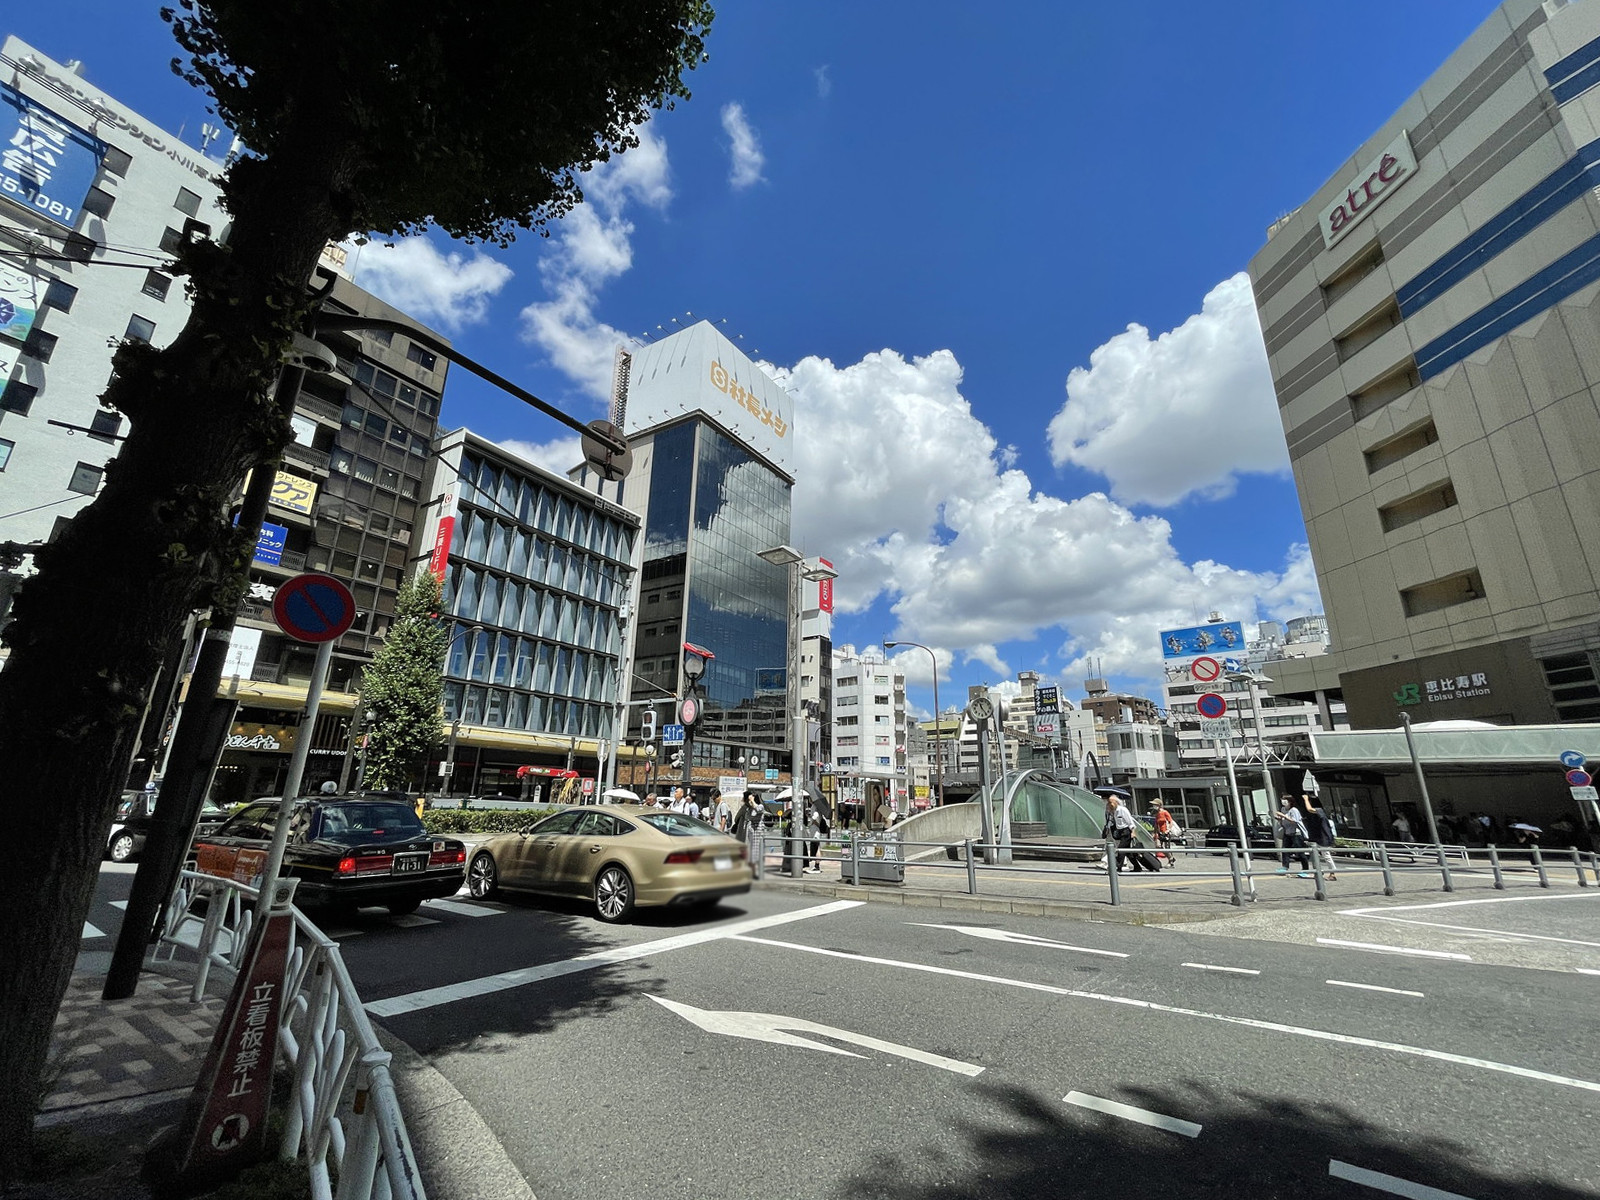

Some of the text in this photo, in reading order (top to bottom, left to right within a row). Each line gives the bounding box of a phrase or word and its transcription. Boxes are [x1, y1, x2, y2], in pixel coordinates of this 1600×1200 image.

[0, 172, 73, 221] 5-1081
[730, 378, 787, 438] 社長メシ
[1393, 683, 1421, 706] JR
[1425, 672, 1488, 694] 恵比寿駅
[1428, 687, 1491, 702] Ebisu Station
[227, 981, 275, 1098] 立看板禁止
